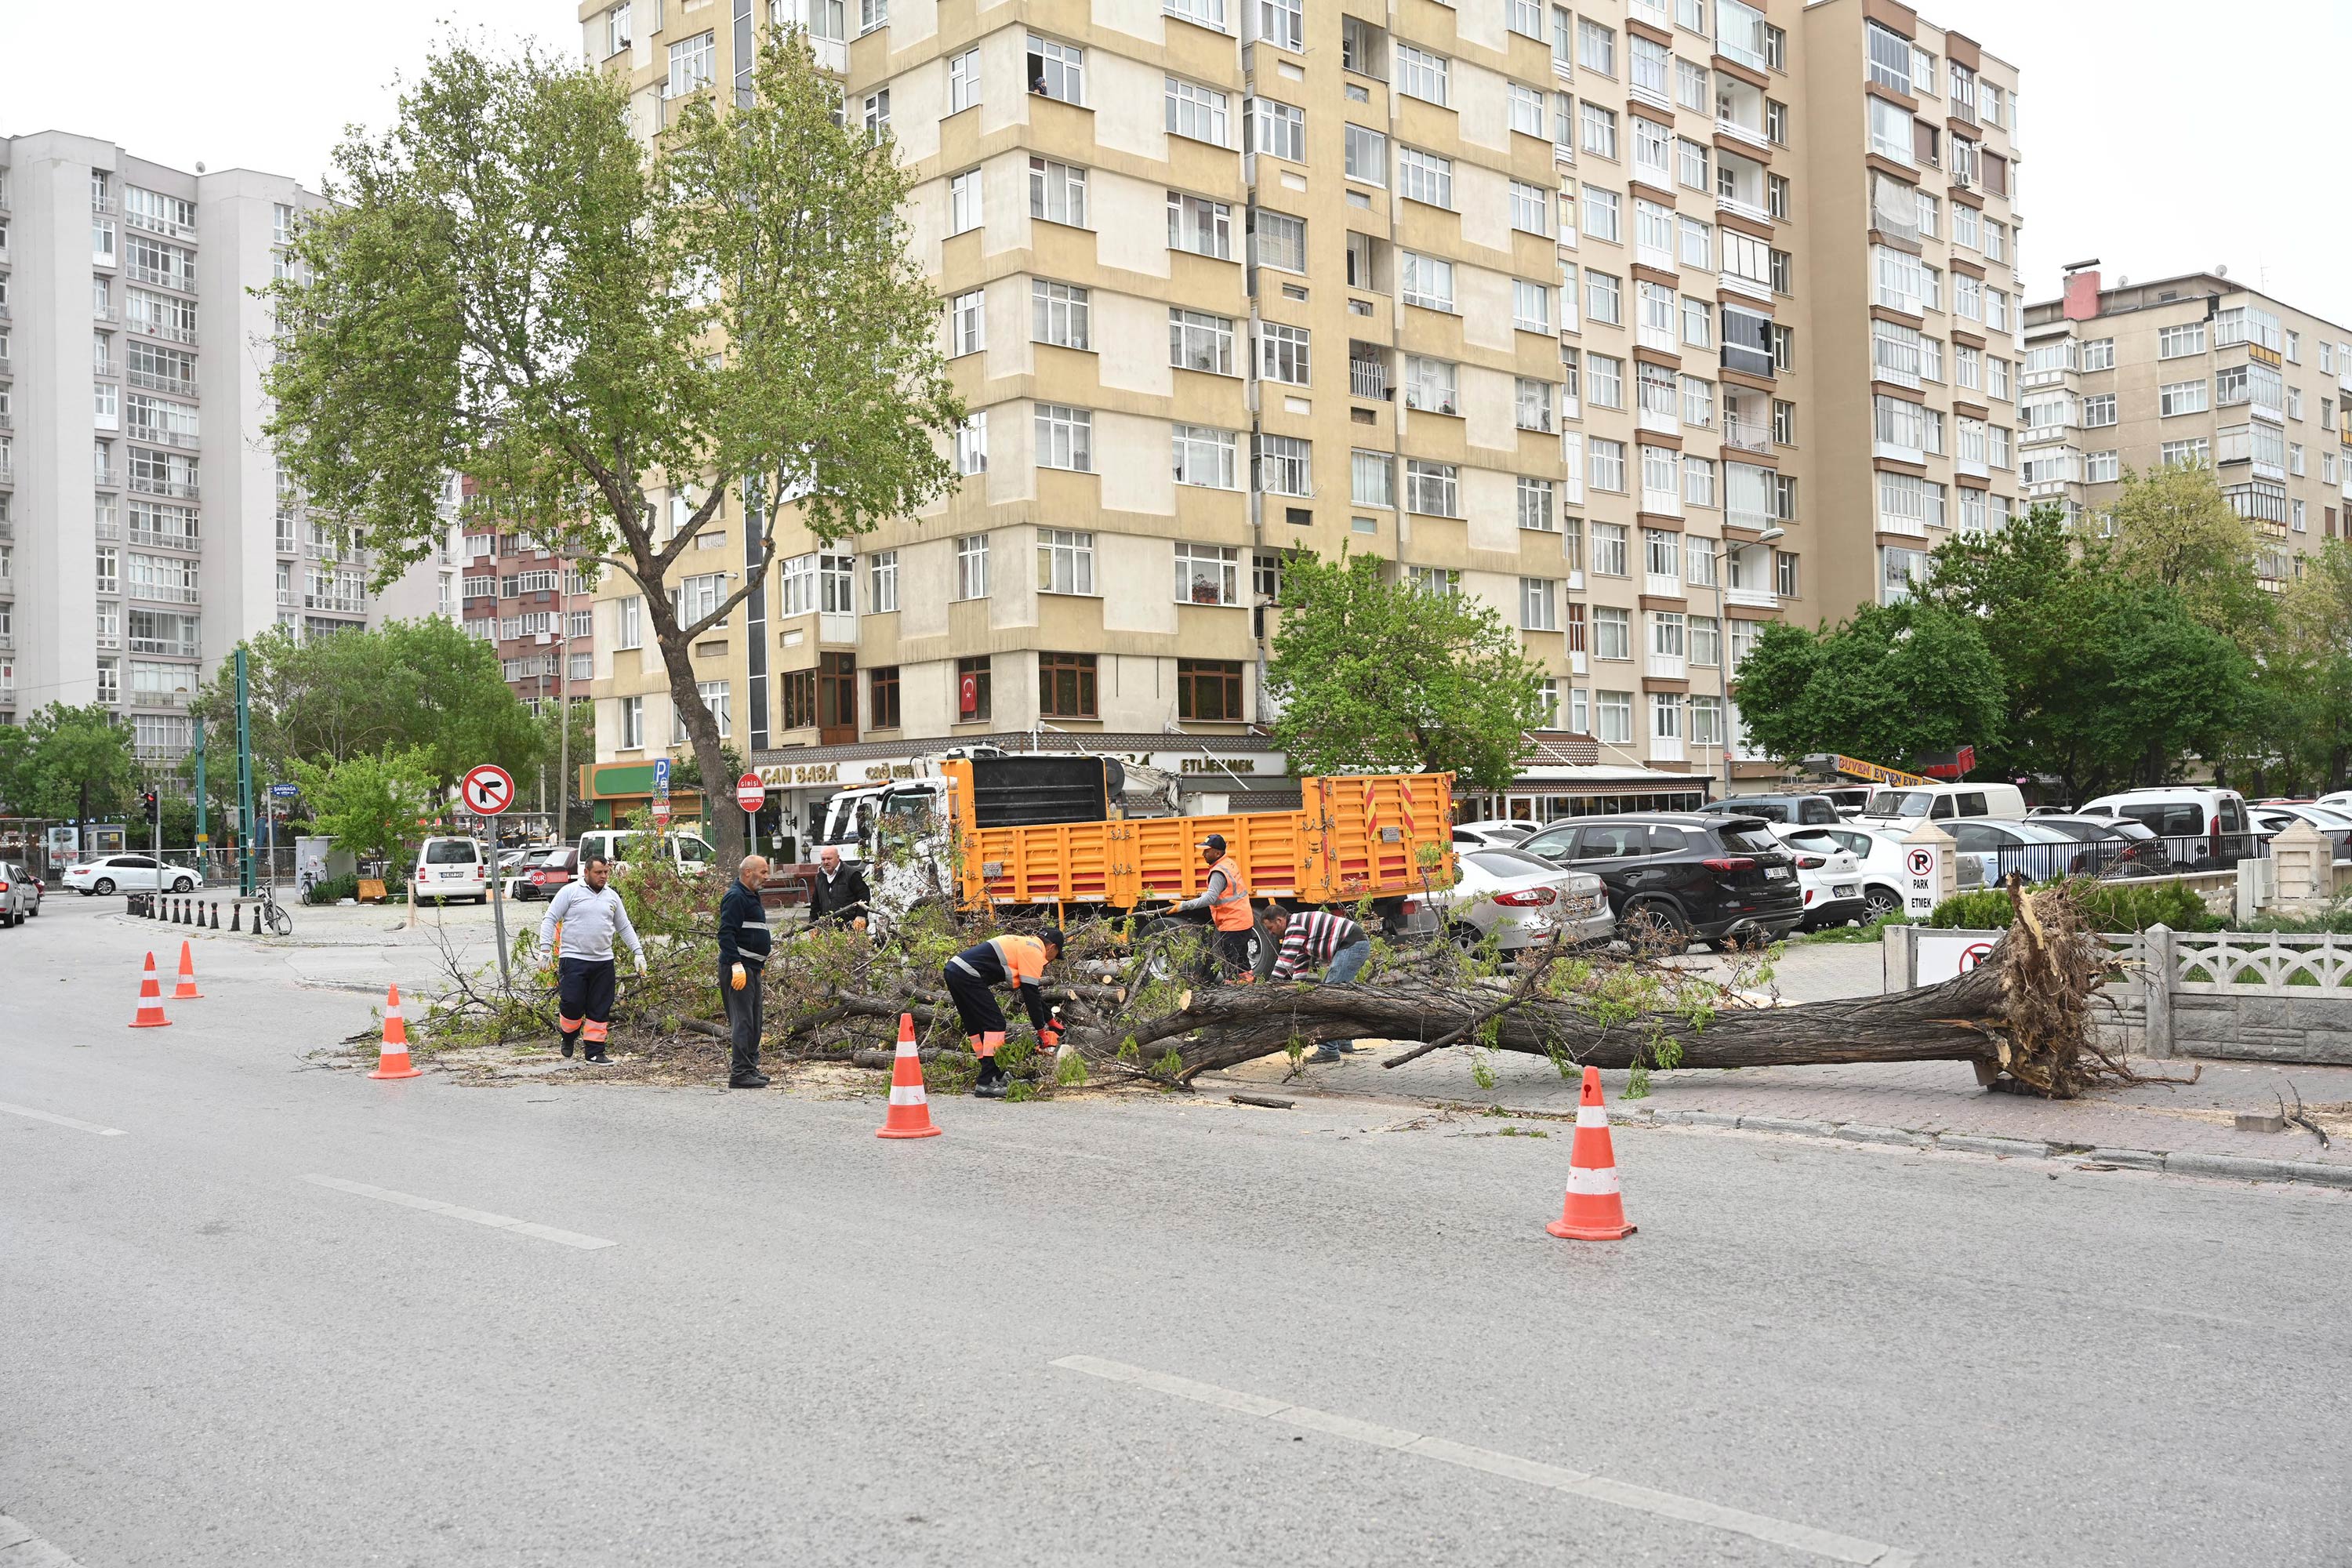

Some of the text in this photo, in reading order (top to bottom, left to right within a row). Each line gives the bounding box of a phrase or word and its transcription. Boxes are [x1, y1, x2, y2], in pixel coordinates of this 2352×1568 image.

[760, 764, 838, 785] CAN BABA
[1838, 757, 1870, 775] GÜVEN
[1904, 776, 1918, 786] EVE
[1913, 879, 1929, 889] PARK
[1911, 898, 1931, 908] ETMEK
